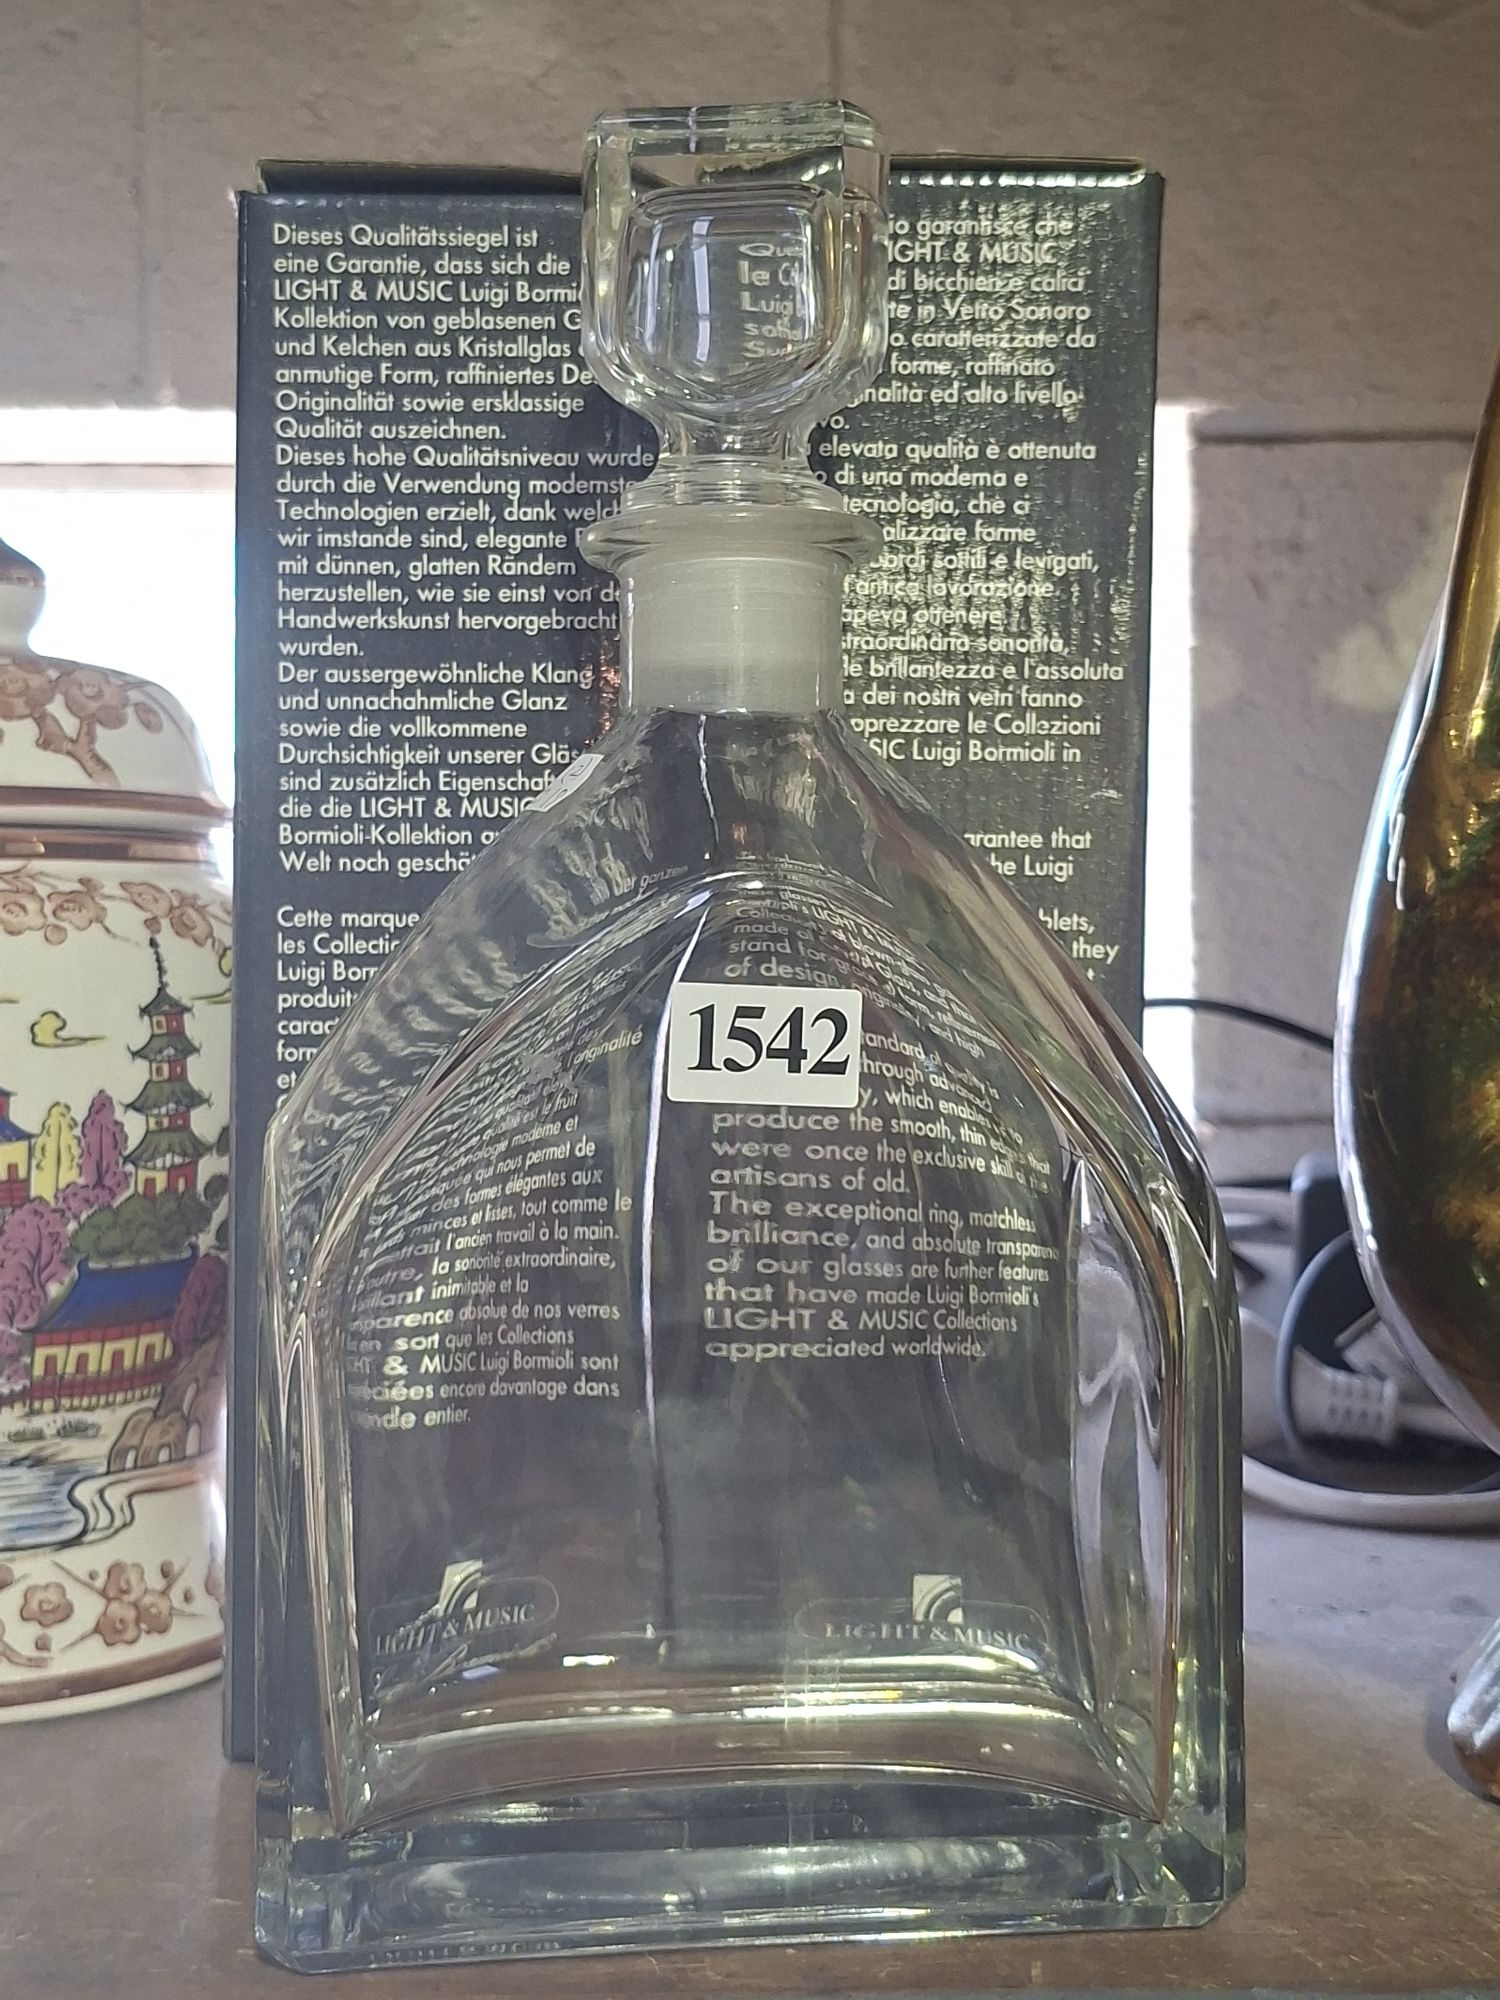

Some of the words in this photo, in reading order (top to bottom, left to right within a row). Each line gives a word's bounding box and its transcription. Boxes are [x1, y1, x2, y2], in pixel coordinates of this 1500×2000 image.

[273, 223, 343, 246] Dieses
[350, 223, 508, 249] Qualitätssiegel
[515, 224, 538, 247] ist
[274, 253, 319, 274] eine
[326, 252, 426, 277] Garantie,
[435, 253, 483, 275] dass
[491, 253, 530, 275] sich
[537, 253, 570, 275] die
[953, 241, 970, 263] &
[979, 241, 1059, 265] MUSIC
[274, 279, 341, 301] LIGHT
[350, 279, 367, 301] &
[376, 280, 454, 302] MUSIC
[460, 281, 509, 307] Luigi
[274, 308, 377, 330] Kollektion
[386, 312, 424, 330] von
[434, 309, 556, 335] geblasenen
[1010, 301, 1091, 320] Sonoro
[1066, 326, 1096, 347] da
[276, 336, 314, 357] und
[323, 336, 406, 358] Kelchen
[415, 341, 451, 358] aus
[459, 336, 571, 362] Kristallglas
[276, 368, 373, 390] anmutige
[380, 365, 439, 388] Form,
[447, 363, 554, 385] raffiniertes
[276, 390, 394, 416] Originalität
[402, 394, 463, 412] sowie
[472, 391, 584, 417] ersklassige
[930, 383, 958, 403] ed
[966, 381, 1008, 403] alto
[276, 417, 363, 440] Qualität
[370, 418, 507, 440] auszeichnen.
[276, 445, 345, 466] Dieses
[352, 445, 406, 466] hohe
[413, 445, 579, 468] Qualitätsniveau
[589, 446, 655, 466] wurde
[819, 436, 897, 457] elevata
[1008, 442, 1096, 459] ottenuta
[276, 473, 335, 493] durch
[343, 473, 375, 494] die
[383, 473, 520, 500] Verwendung
[835, 465, 854, 485] di
[862, 471, 902, 485] una
[911, 466, 1006, 486] moderna
[1014, 471, 1028, 486] e
[276, 500, 418, 526] Technologien
[426, 500, 495, 523] erzielt,
[504, 501, 557, 521] dank
[279, 530, 310, 548] wir
[318, 528, 411, 548] imstande
[420, 528, 468, 550] sind,
[476, 529, 567, 553] elegante
[279, 556, 309, 576] mit
[316, 556, 401, 578] dünnen,
[408, 556, 479, 581] glatten
[488, 556, 576, 576] Rändern
[278, 581, 408, 604] herzustellen,
[417, 583, 454, 602] wie
[462, 584, 491, 602] sie
[498, 584, 545, 602] einst
[554, 588, 591, 602] von
[278, 607, 449, 629] Handwerkskunst
[458, 608, 618, 634] hervorgebracht
[279, 634, 363, 657] wurden.
[279, 662, 318, 684] Der
[325, 661, 524, 689] aussergewöhnliche
[531, 663, 595, 689] Klang
[1025, 659, 1123, 679] l'assoluta
[279, 689, 318, 711] und
[327, 689, 494, 711] unnachahmliche
[502, 689, 568, 711] Glanz
[863, 685, 896, 706] dei
[904, 687, 960, 707] nostri
[1021, 686, 1083, 708] fanno
[279, 718, 341, 738] sowie
[349, 716, 382, 738] die
[389, 716, 528, 738] vollkommene
[968, 712, 986, 734] le
[994, 713, 1101, 736] Collezioni
[279, 743, 441, 770] Durchsichtigkeit
[449, 748, 522, 764] unserer
[913, 738, 962, 766] Luigi
[968, 740, 1055, 762] Bormioli
[279, 771, 321, 791] sind
[329, 771, 431, 791] zusätzlich
[279, 798, 311, 818] die
[320, 798, 352, 818] die
[360, 798, 426, 818] LIGHT
[434, 798, 451, 818] &
[279, 824, 472, 846] Bormioli-Kollektion
[1051, 827, 1091, 848] that
[280, 851, 331, 872] Welt
[339, 851, 389, 872] noch
[1024, 854, 1073, 882] Luigi
[278, 906, 332, 928] Cette
[341, 912, 420, 936] marque
[278, 933, 305, 954] les
[1072, 937, 1119, 962] they
[278, 959, 325, 982] Luigi
[687, 1002, 851, 1077] 1542
[712, 1106, 840, 1133] produce
[850, 1110, 883, 1132] the
[891, 1113, 956, 1144] smooth,
[575, 1135, 596, 1156] de
[711, 1142, 791, 1158] were
[805, 1144, 868, 1161] once
[878, 1137, 906, 1162] the
[914, 1145, 986, 1173] exclusive
[711, 1165, 831, 1189] artisans
[842, 1171, 866, 1191] of
[872, 1172, 910, 1193] old.
[552, 1197, 608, 1213] comme
[615, 1188, 632, 1211] le
[709, 1191, 771, 1215] The
[785, 1200, 922, 1224] exceptional
[929, 1208, 962, 1229] ring,
[970, 1208, 1036, 1232] matchless
[554, 1219, 568, 1240] la
[574, 1220, 619, 1239] main.
[707, 1221, 855, 1247] brilliance,
[866, 1233, 905, 1250] and
[912, 1235, 981, 1254] absolute
[505, 1250, 616, 1268] extraordinaire,
[708, 1250, 744, 1272] of
[757, 1257, 812, 1273] our
[823, 1254, 902, 1280] glasses
[911, 1261, 938, 1278] are
[944, 1259, 993, 1280] further
[704, 1278, 774, 1301] that
[788, 1281, 857, 1302] have
[866, 1283, 920, 1304] made
[927, 1288, 963, 1307] Luigi
[459, 1300, 507, 1320] absolue
[512, 1298, 529, 1319] de
[534, 1303, 561, 1319] nos
[567, 1302, 620, 1320] verres
[704, 1308, 816, 1329] LIGHT
[827, 1309, 849, 1329] &
[858, 1309, 929, 1329] MUSIC
[934, 1311, 1017, 1332] Collections
[497, 1325, 574, 1344] Collections
[706, 1337, 884, 1361] appreciated
[419, 1354, 476, 1374] MUSIC
[481, 1354, 509, 1374] Luigi
[513, 1350, 574, 1372] Bormioli
[581, 1354, 619, 1371] sont
[490, 1378, 568, 1400] davantage
[573, 1376, 620, 1397] dans
[464, 1604, 535, 1633] MUSIC
[930, 1626, 949, 1641] &
[954, 1627, 1030, 1650] MUSIC
